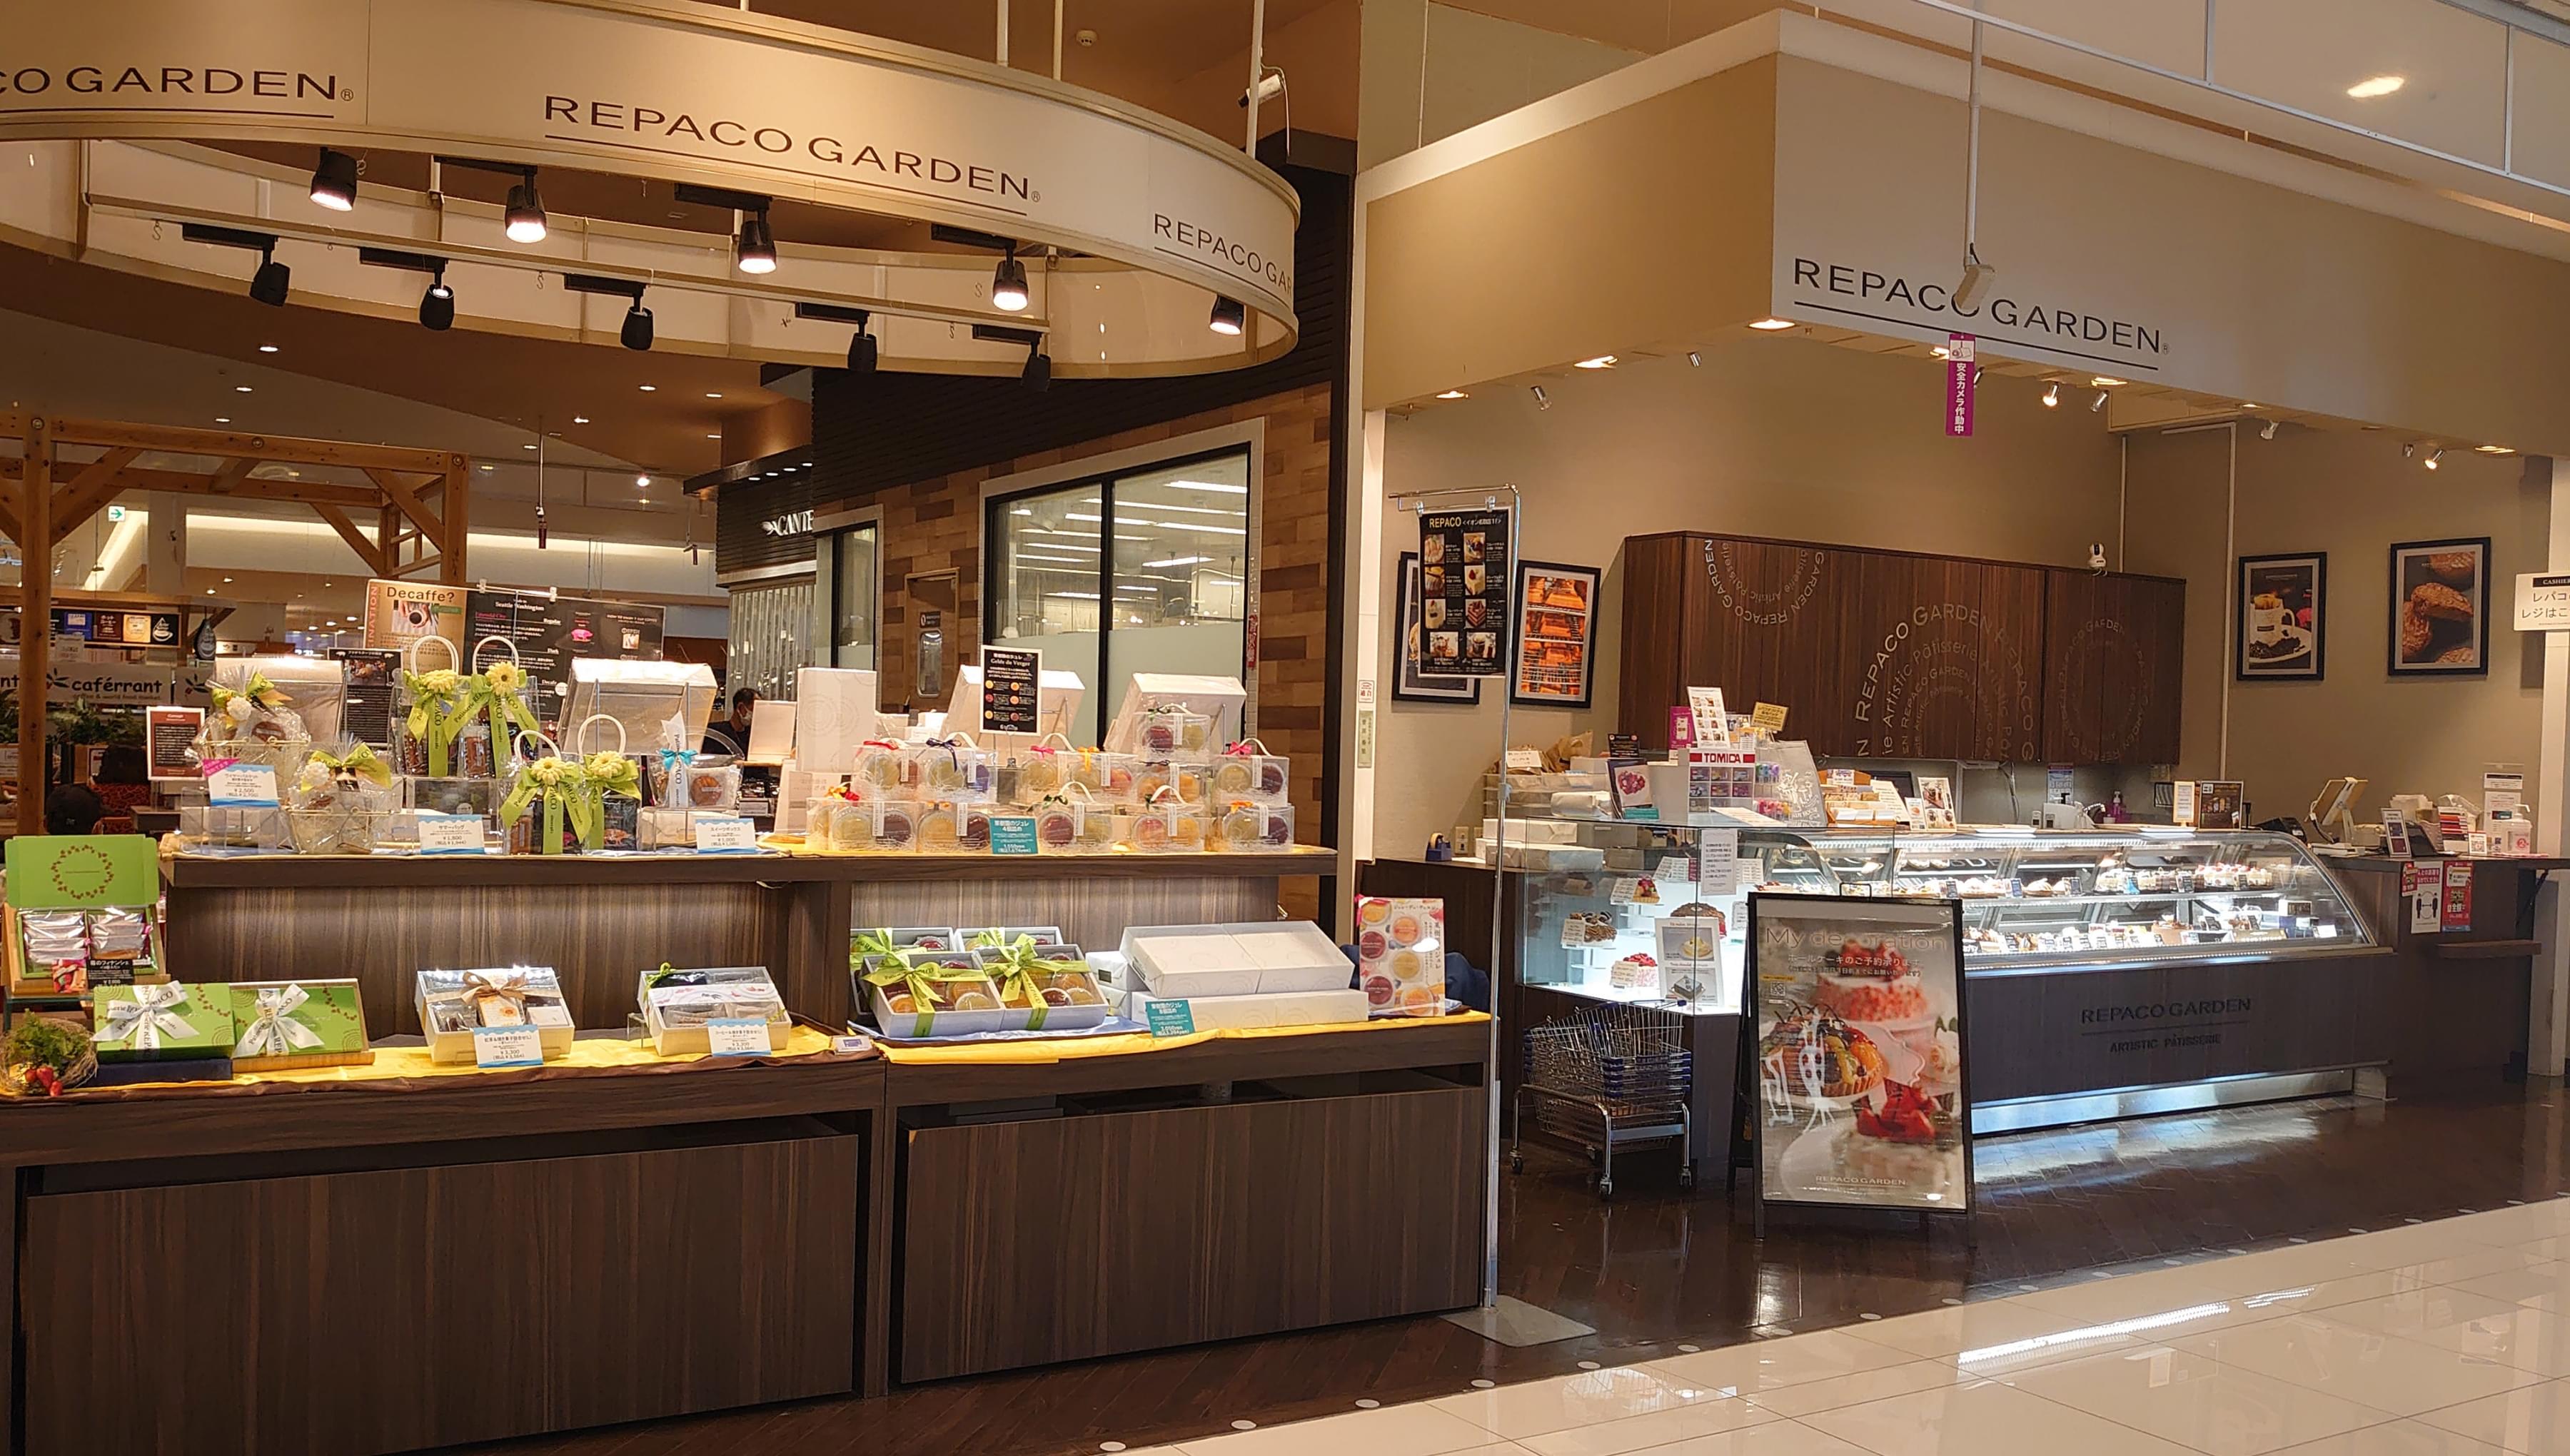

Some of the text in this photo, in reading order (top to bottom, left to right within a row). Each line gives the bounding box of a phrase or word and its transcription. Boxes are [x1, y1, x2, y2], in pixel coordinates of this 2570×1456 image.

[66, 66, 336, 101] GARDEN
[545, 95, 1029, 201] REPACO GARDEN
[1154, 213, 1262, 274] REPACO
[1990, 299, 2161, 355] GARDEN
[1953, 362, 1967, 435] 安全カメラ作動中
[1428, 516, 1462, 528] REPACO
[387, 587, 455, 602] Decaffe?
[1704, 540, 1825, 625] GARDEN REPACO GARDEN
[2533, 591, 2570, 602] レパコ
[1855, 622, 1909, 722] REPACO
[1913, 603, 1993, 635] GARDEN
[71, 677, 163, 694] caférrant
[1703, 753, 1742, 764] TOMICA
[1765, 927, 1947, 951] My decoration
[2081, 997, 2251, 1024] REPACO GARDEN
[2110, 1038, 2159, 1053] ARTISTIC
